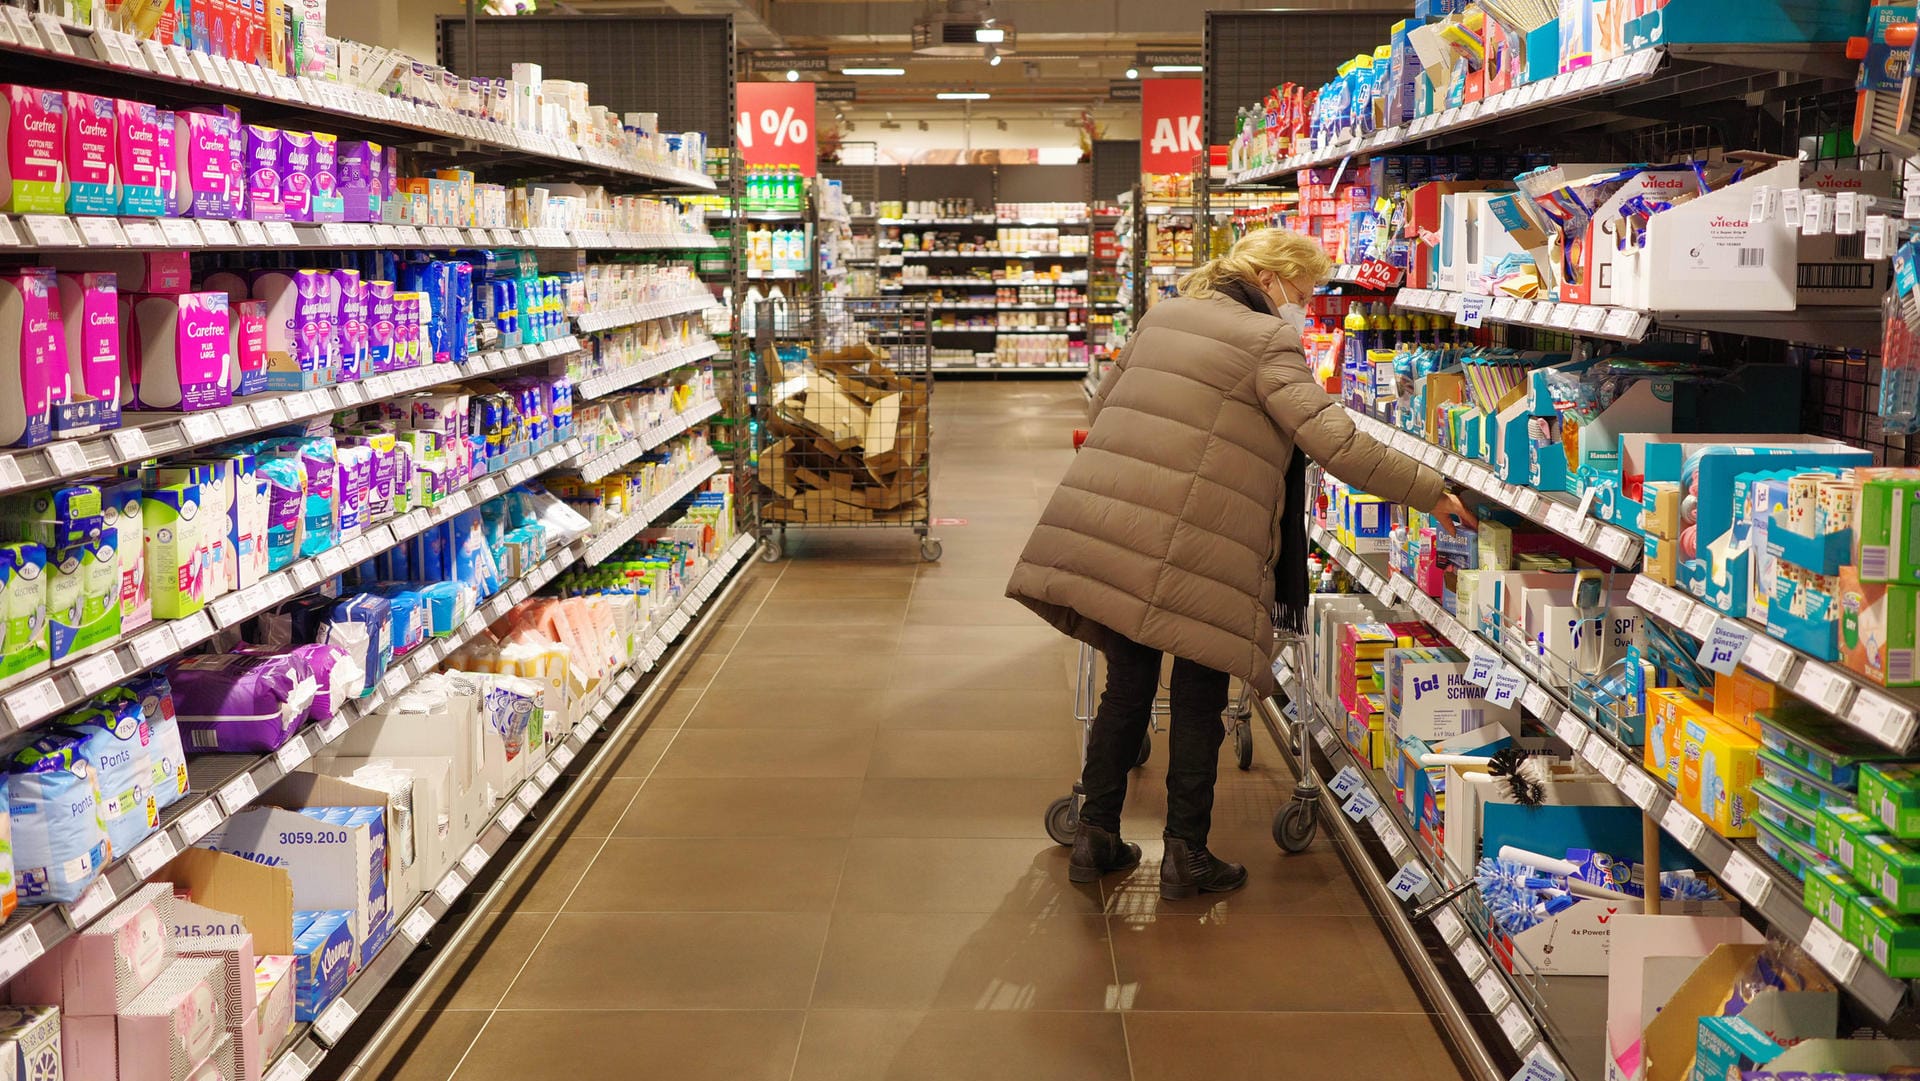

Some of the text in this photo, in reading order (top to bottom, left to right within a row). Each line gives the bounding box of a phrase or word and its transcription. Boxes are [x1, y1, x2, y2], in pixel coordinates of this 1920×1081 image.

[304, 10, 321, 21] Gel
[1879, 15, 1909, 24] BESEN
[24, 113, 56, 135] Carefree
[79, 118, 108, 138] Carefree
[759, 106, 808, 147] %
[128, 125, 154, 144] Carefree
[1151, 115, 1202, 154] AK
[199, 136, 225, 154] Carefree
[1641, 175, 1684, 189] vileda
[1815, 174, 1862, 188] vileda
[1710, 216, 1749, 228] vileda
[1374, 263, 1391, 282] %
[91, 311, 117, 326] Carefree
[1464, 310, 1479, 322] ja!
[29, 317, 48, 334] Carefree
[187, 321, 225, 339] Carefree
[246, 321, 263, 334] Carefree
[201, 342, 214, 352] PLUS
[200, 350, 216, 362] LARGE
[1715, 627, 1748, 642] Discount-
[1712, 637, 1743, 650] günstig?
[1710, 647, 1732, 664] ja!
[1473, 662, 1494, 672] günstig?
[1447, 674, 1474, 687] HAU
[1472, 668, 1488, 681] ja!
[1496, 674, 1521, 685] Discount-
[1412, 674, 1440, 701] ja!
[1495, 682, 1517, 692] günstig?
[1494, 688, 1511, 701] ja!
[119, 722, 135, 735] TENA
[99, 748, 130, 771] Pants
[1335, 780, 1349, 792] ja!
[71, 793, 94, 819] Pants
[108, 802, 118, 813] M
[1349, 803, 1364, 815] ja!
[1730, 793, 1745, 832] Swiffer
[279, 832, 347, 845] 3059.20.0
[81, 858, 88, 870] L
[1395, 880, 1412, 893] ja!
[174, 924, 240, 937] 215200
[321, 939, 353, 981] Kleenex
[1531, 1059, 1558, 1079] Discount-
